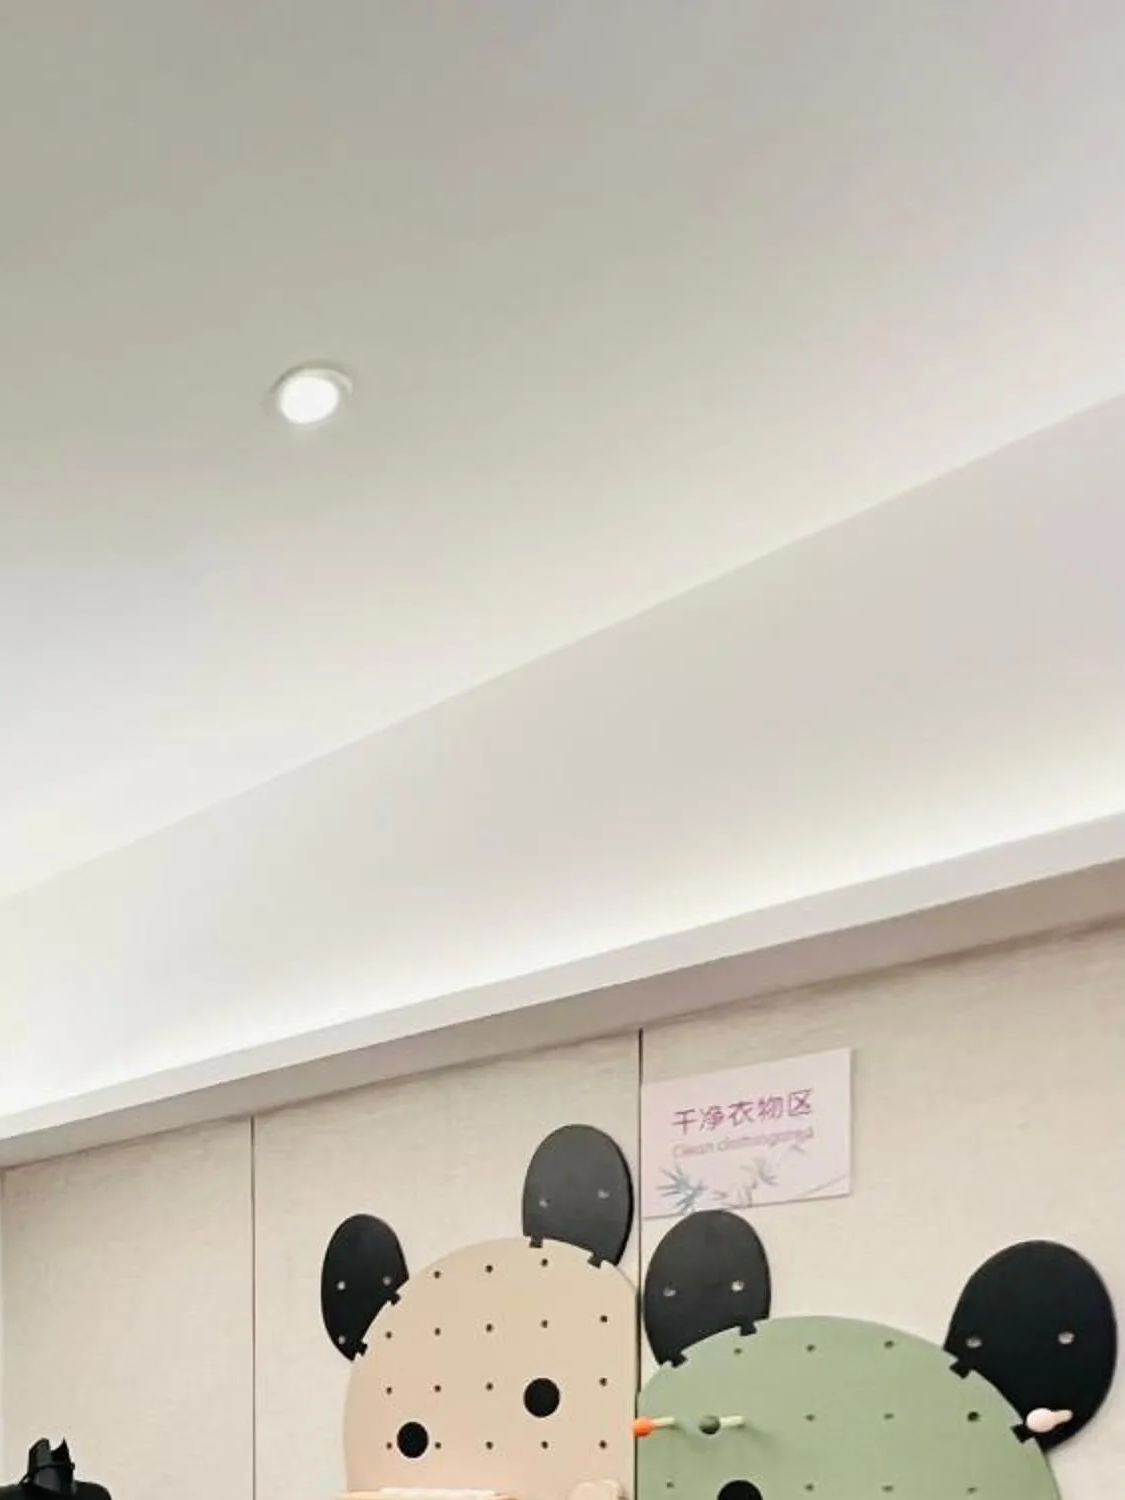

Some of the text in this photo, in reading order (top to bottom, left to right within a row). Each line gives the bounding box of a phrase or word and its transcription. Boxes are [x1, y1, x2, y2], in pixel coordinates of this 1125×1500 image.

[672, 1088, 813, 1135] 干净衣物区
